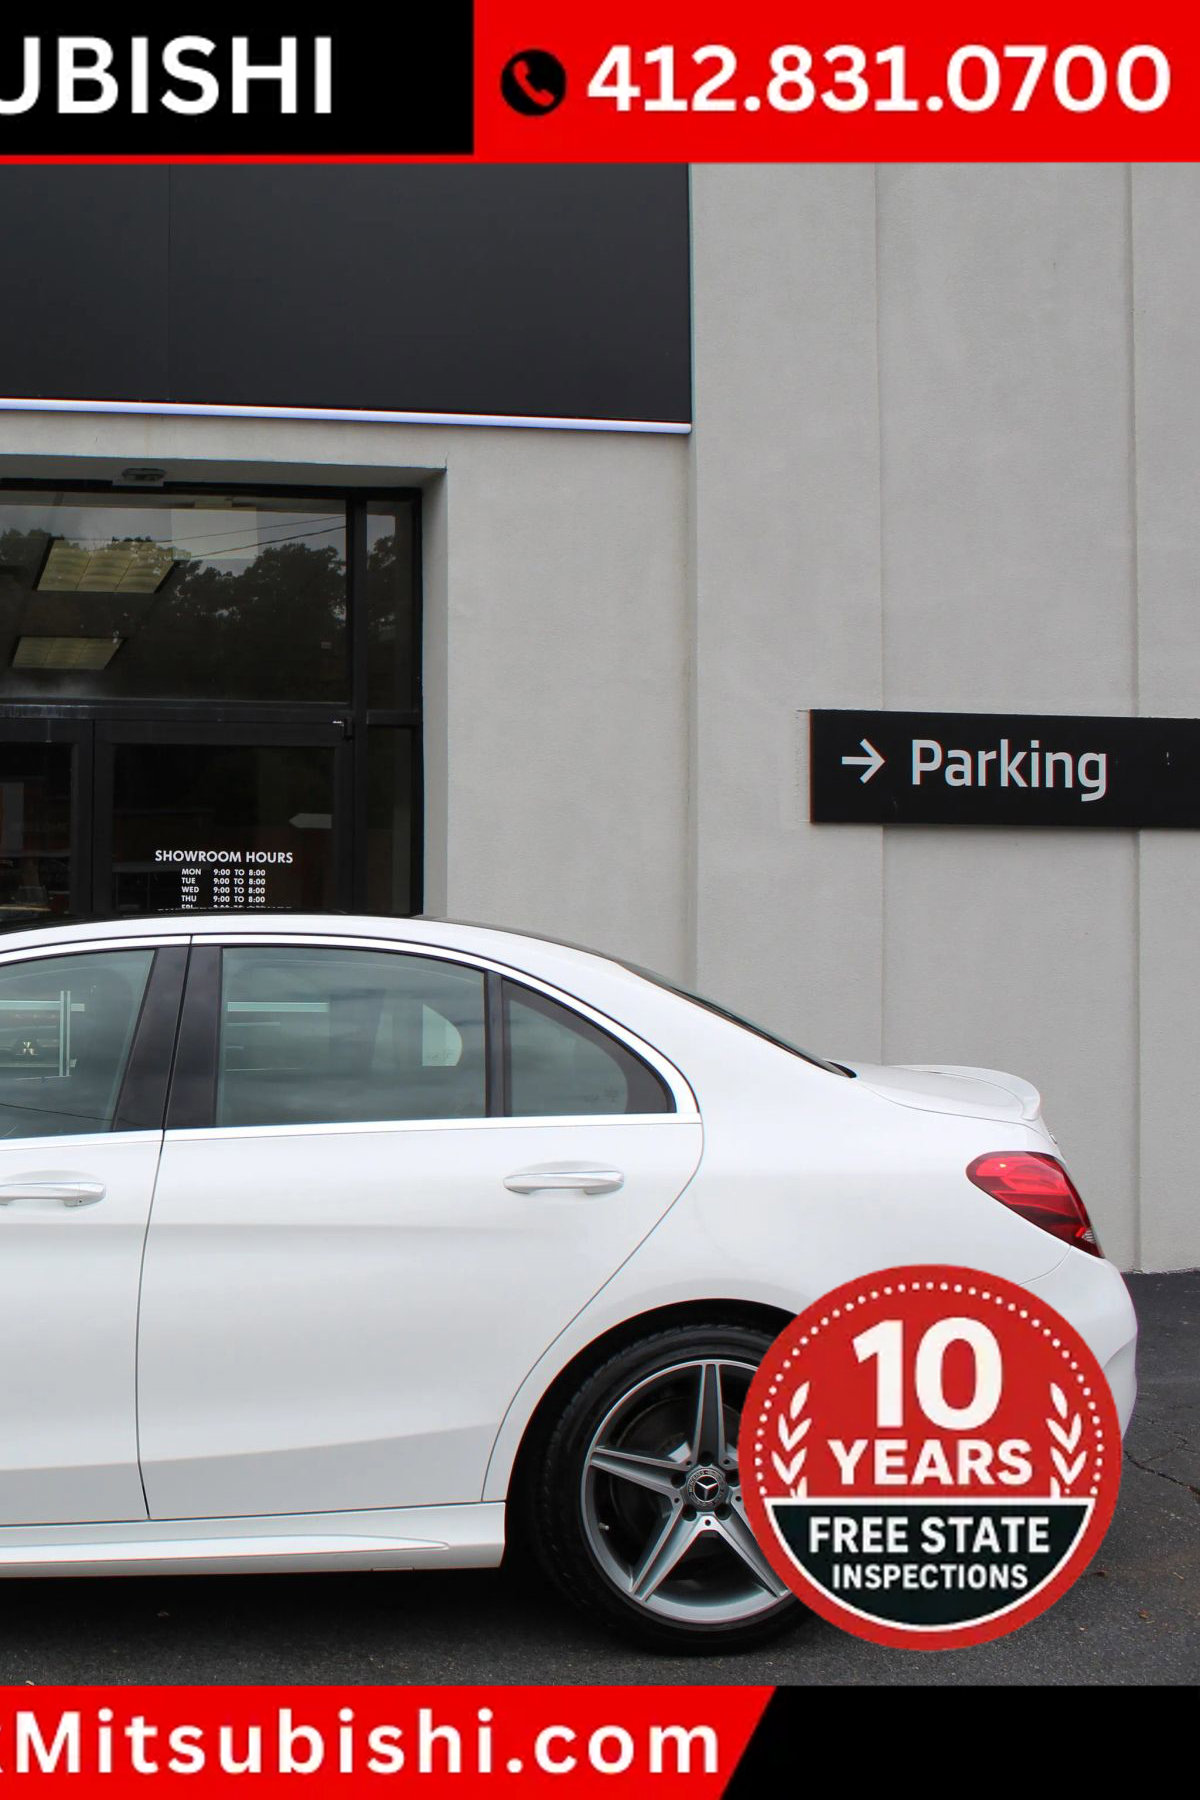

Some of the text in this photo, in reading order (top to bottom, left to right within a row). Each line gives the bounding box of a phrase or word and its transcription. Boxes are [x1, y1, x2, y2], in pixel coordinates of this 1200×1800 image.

[911, 738, 1108, 802] Parking
[154, 849, 294, 864] SHOWROOM HOURS
